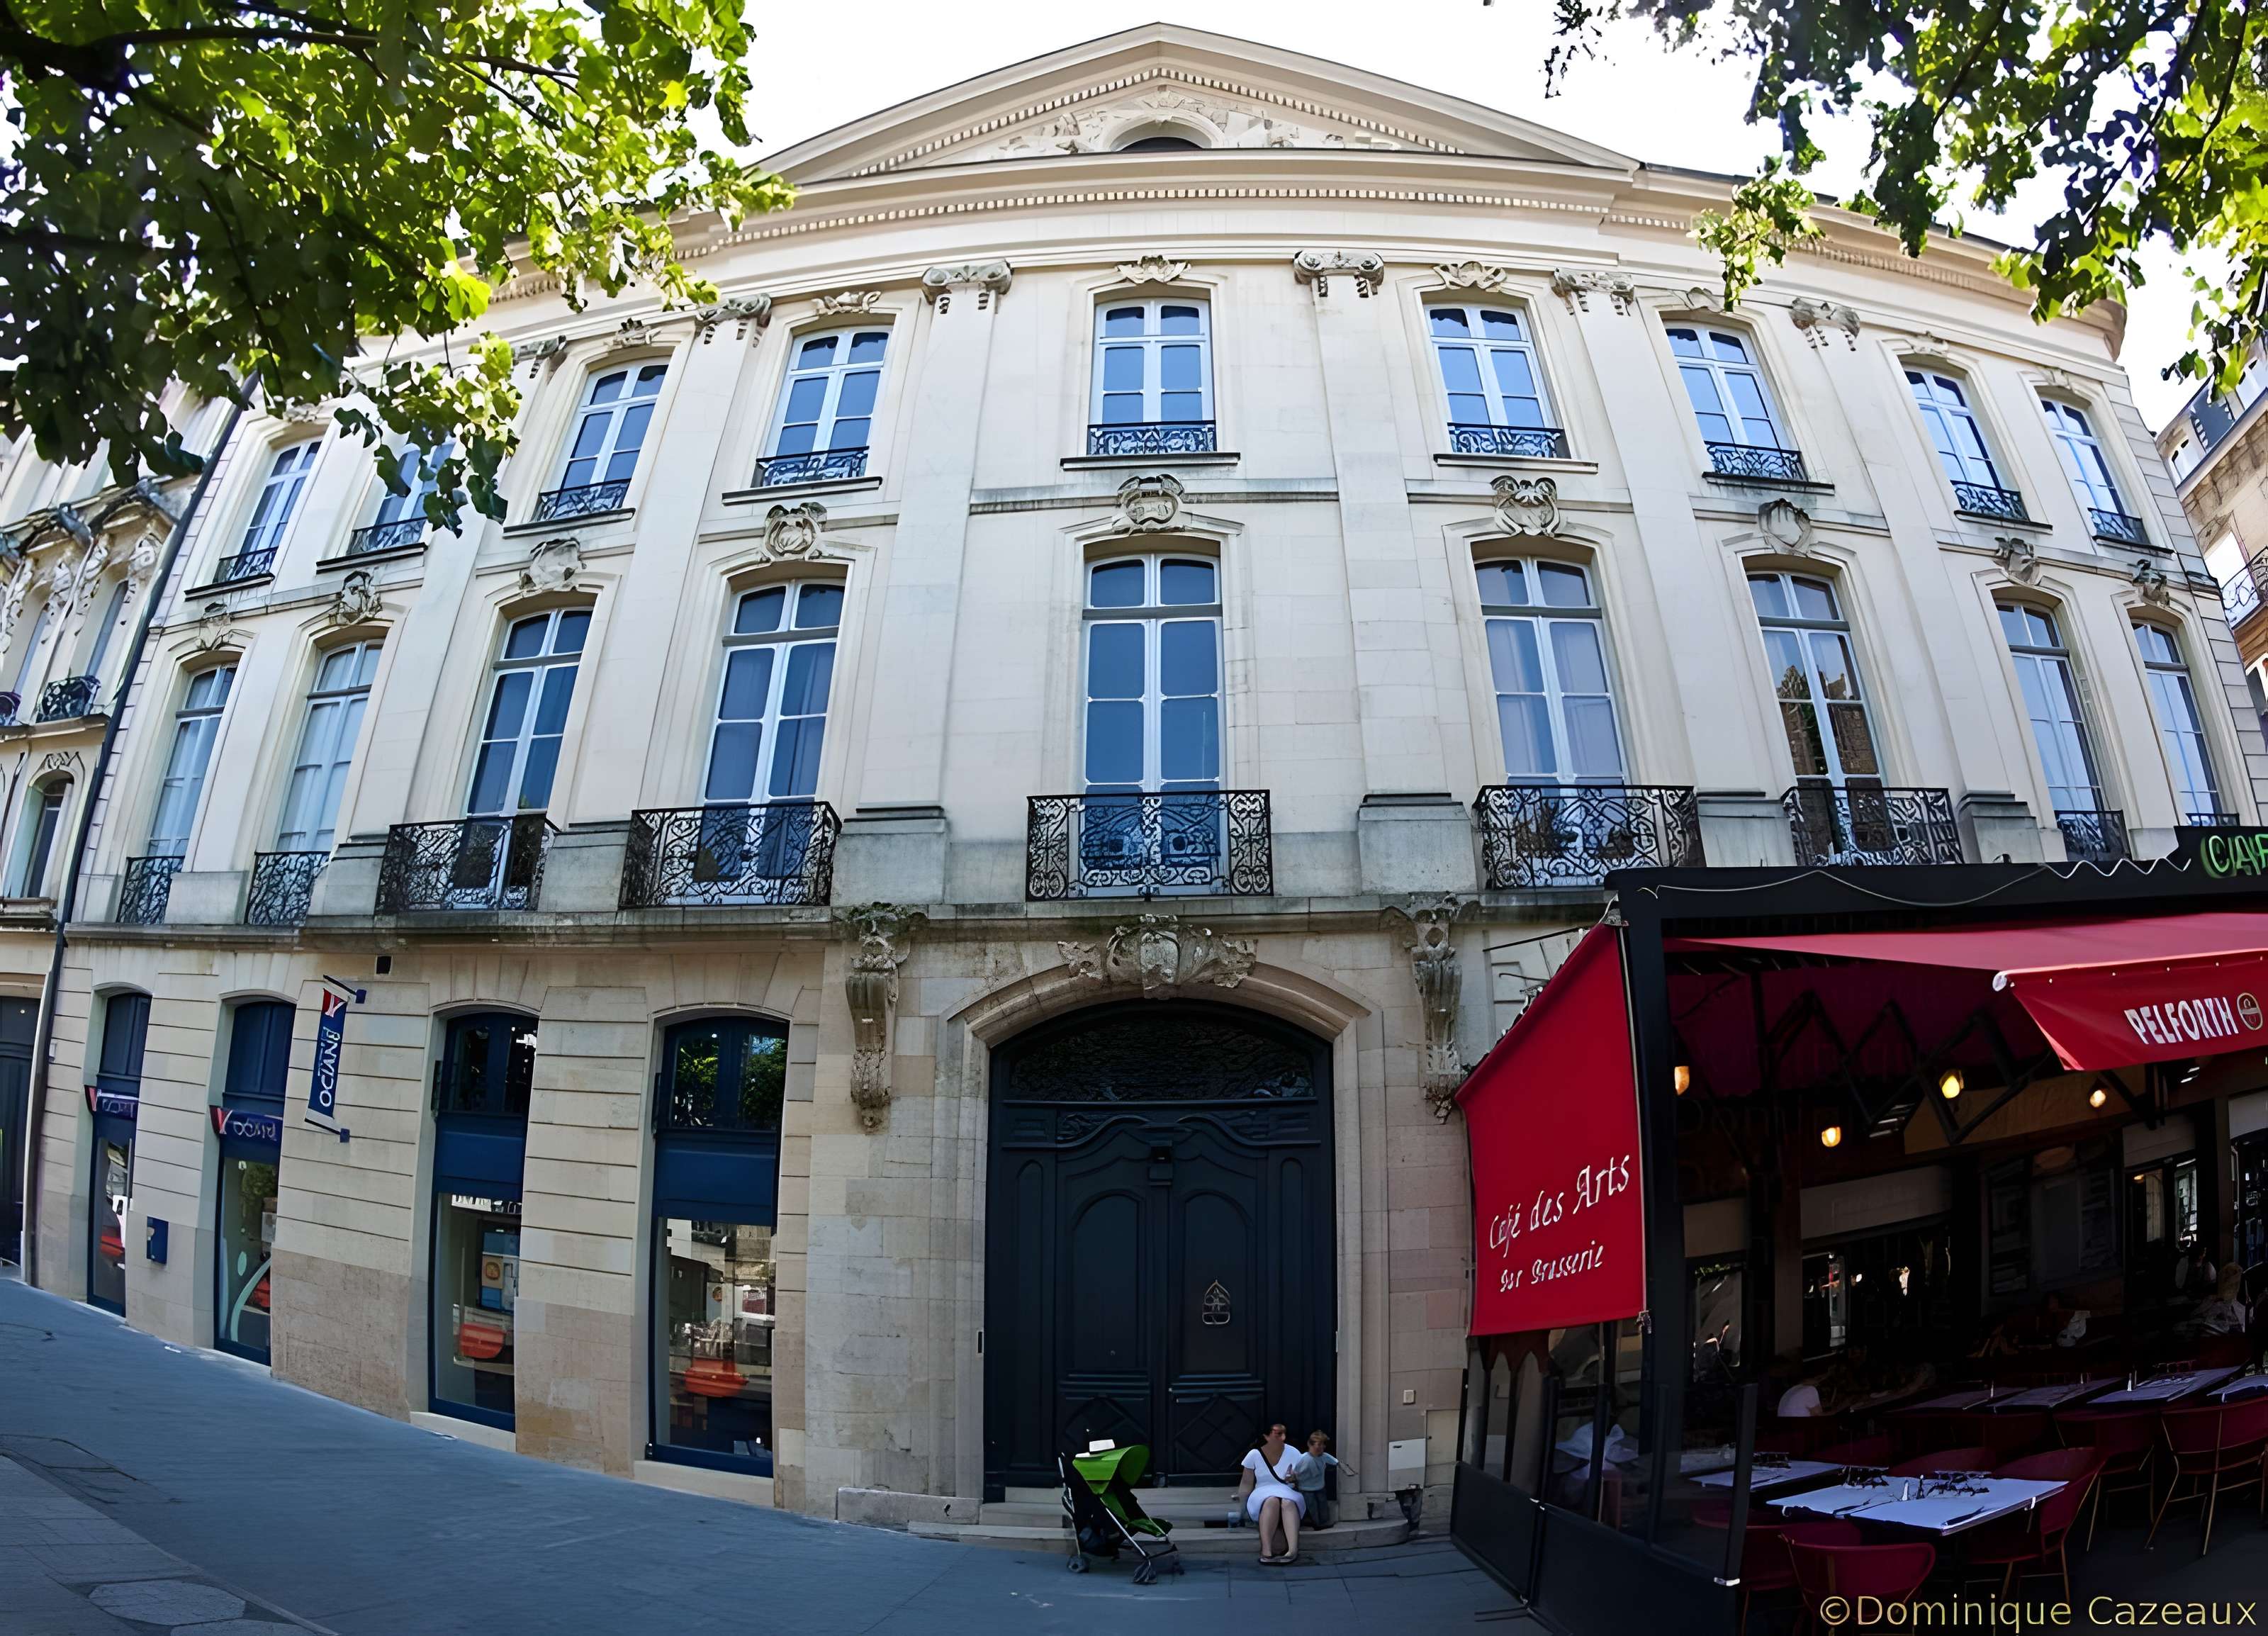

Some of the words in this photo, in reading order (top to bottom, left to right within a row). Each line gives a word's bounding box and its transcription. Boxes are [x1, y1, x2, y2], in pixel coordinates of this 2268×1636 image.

[2124, 997, 2239, 1045] PELFORTH
[1490, 1203, 1521, 1258] Café
[1530, 1190, 1564, 1231] des
[1573, 1155, 1629, 1214] Arts
[1531, 1240, 1604, 1284] Brasserie
